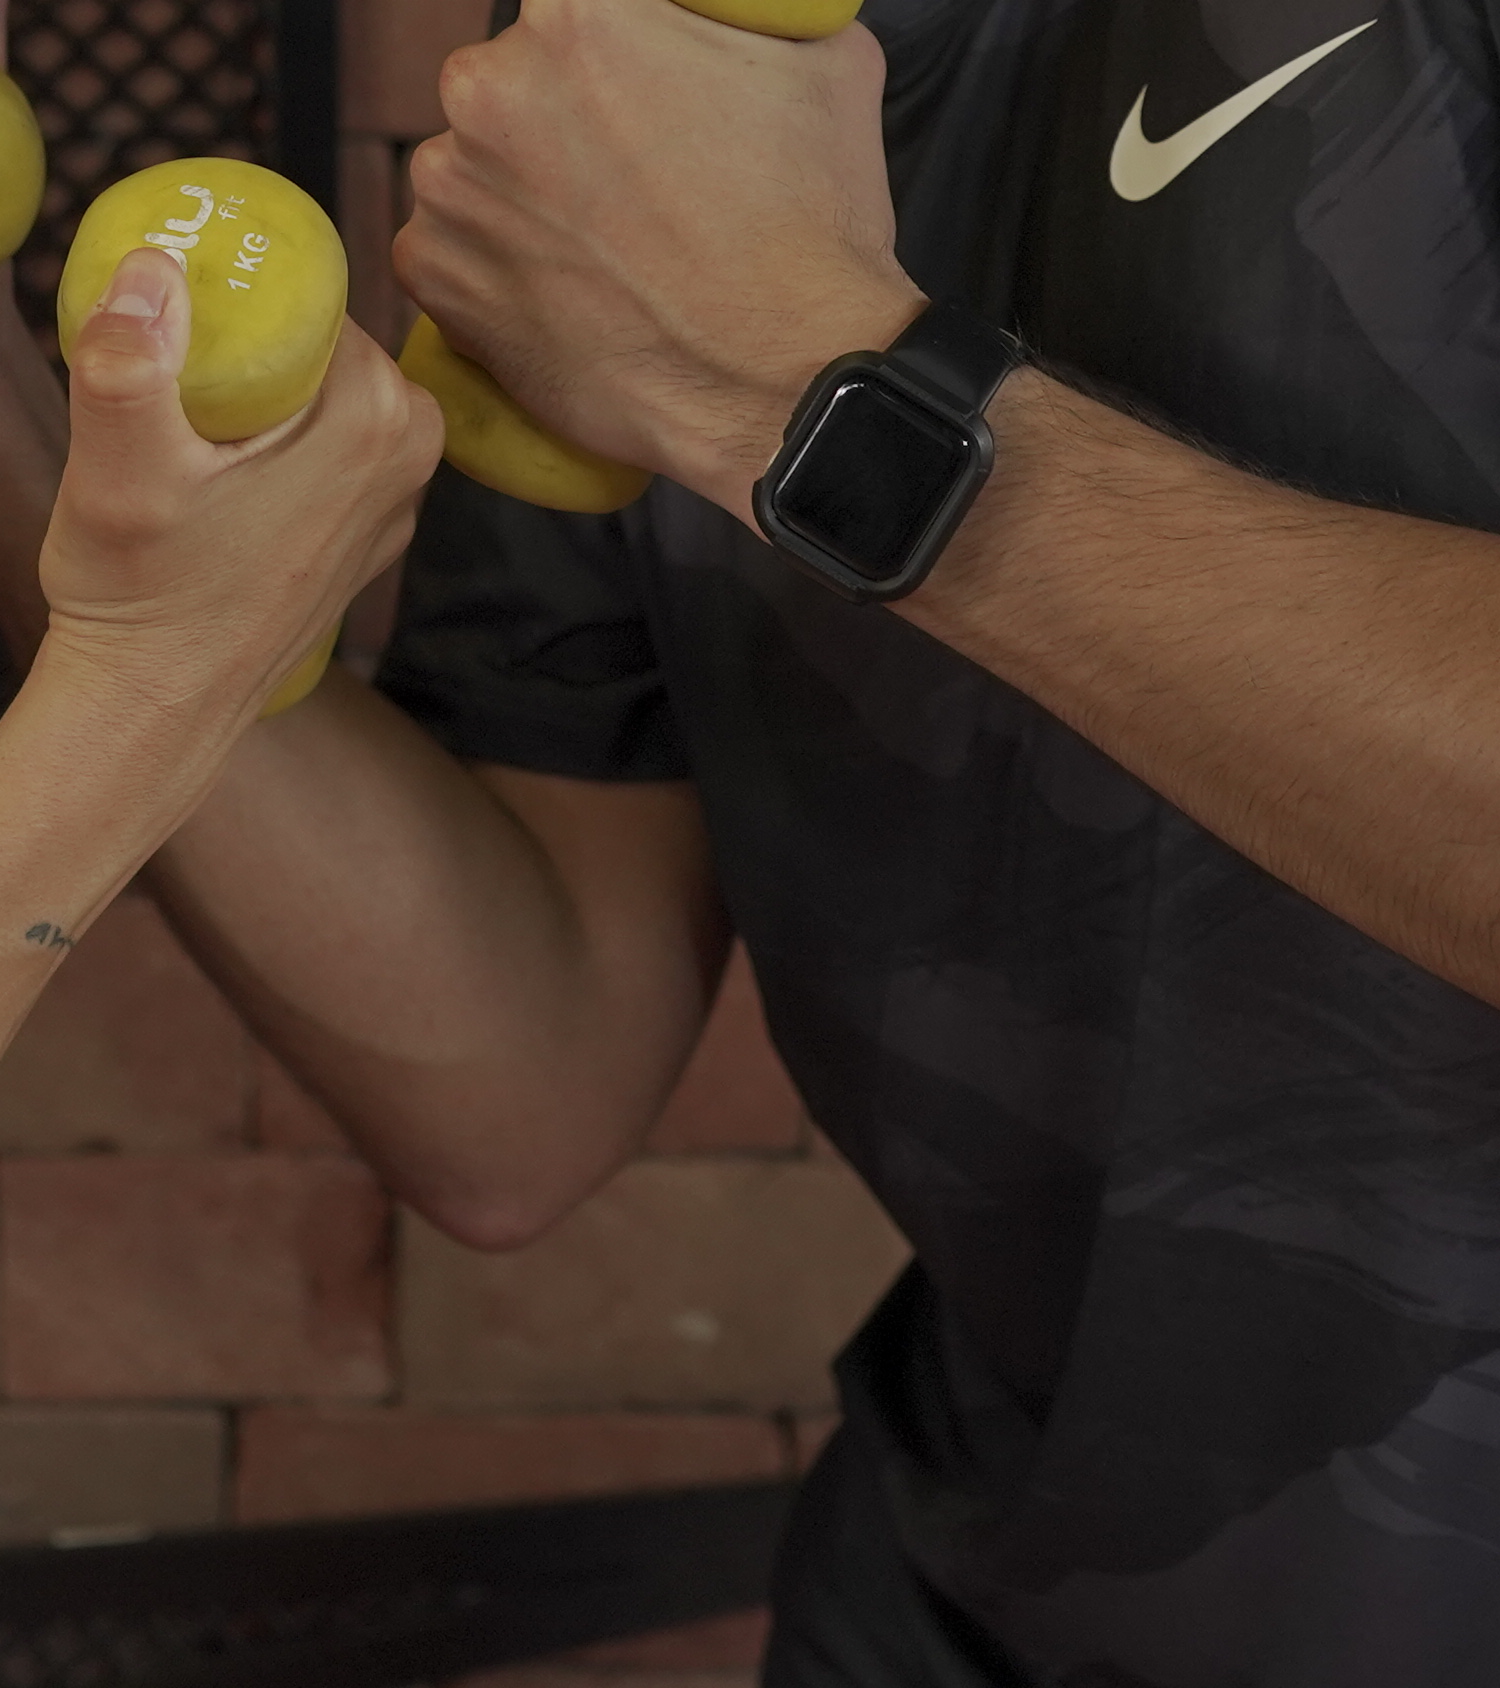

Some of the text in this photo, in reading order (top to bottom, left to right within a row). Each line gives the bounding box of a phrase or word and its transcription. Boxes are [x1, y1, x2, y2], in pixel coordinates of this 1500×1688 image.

[217, 194, 246, 222] fit
[227, 232, 271, 292] 1 KG
